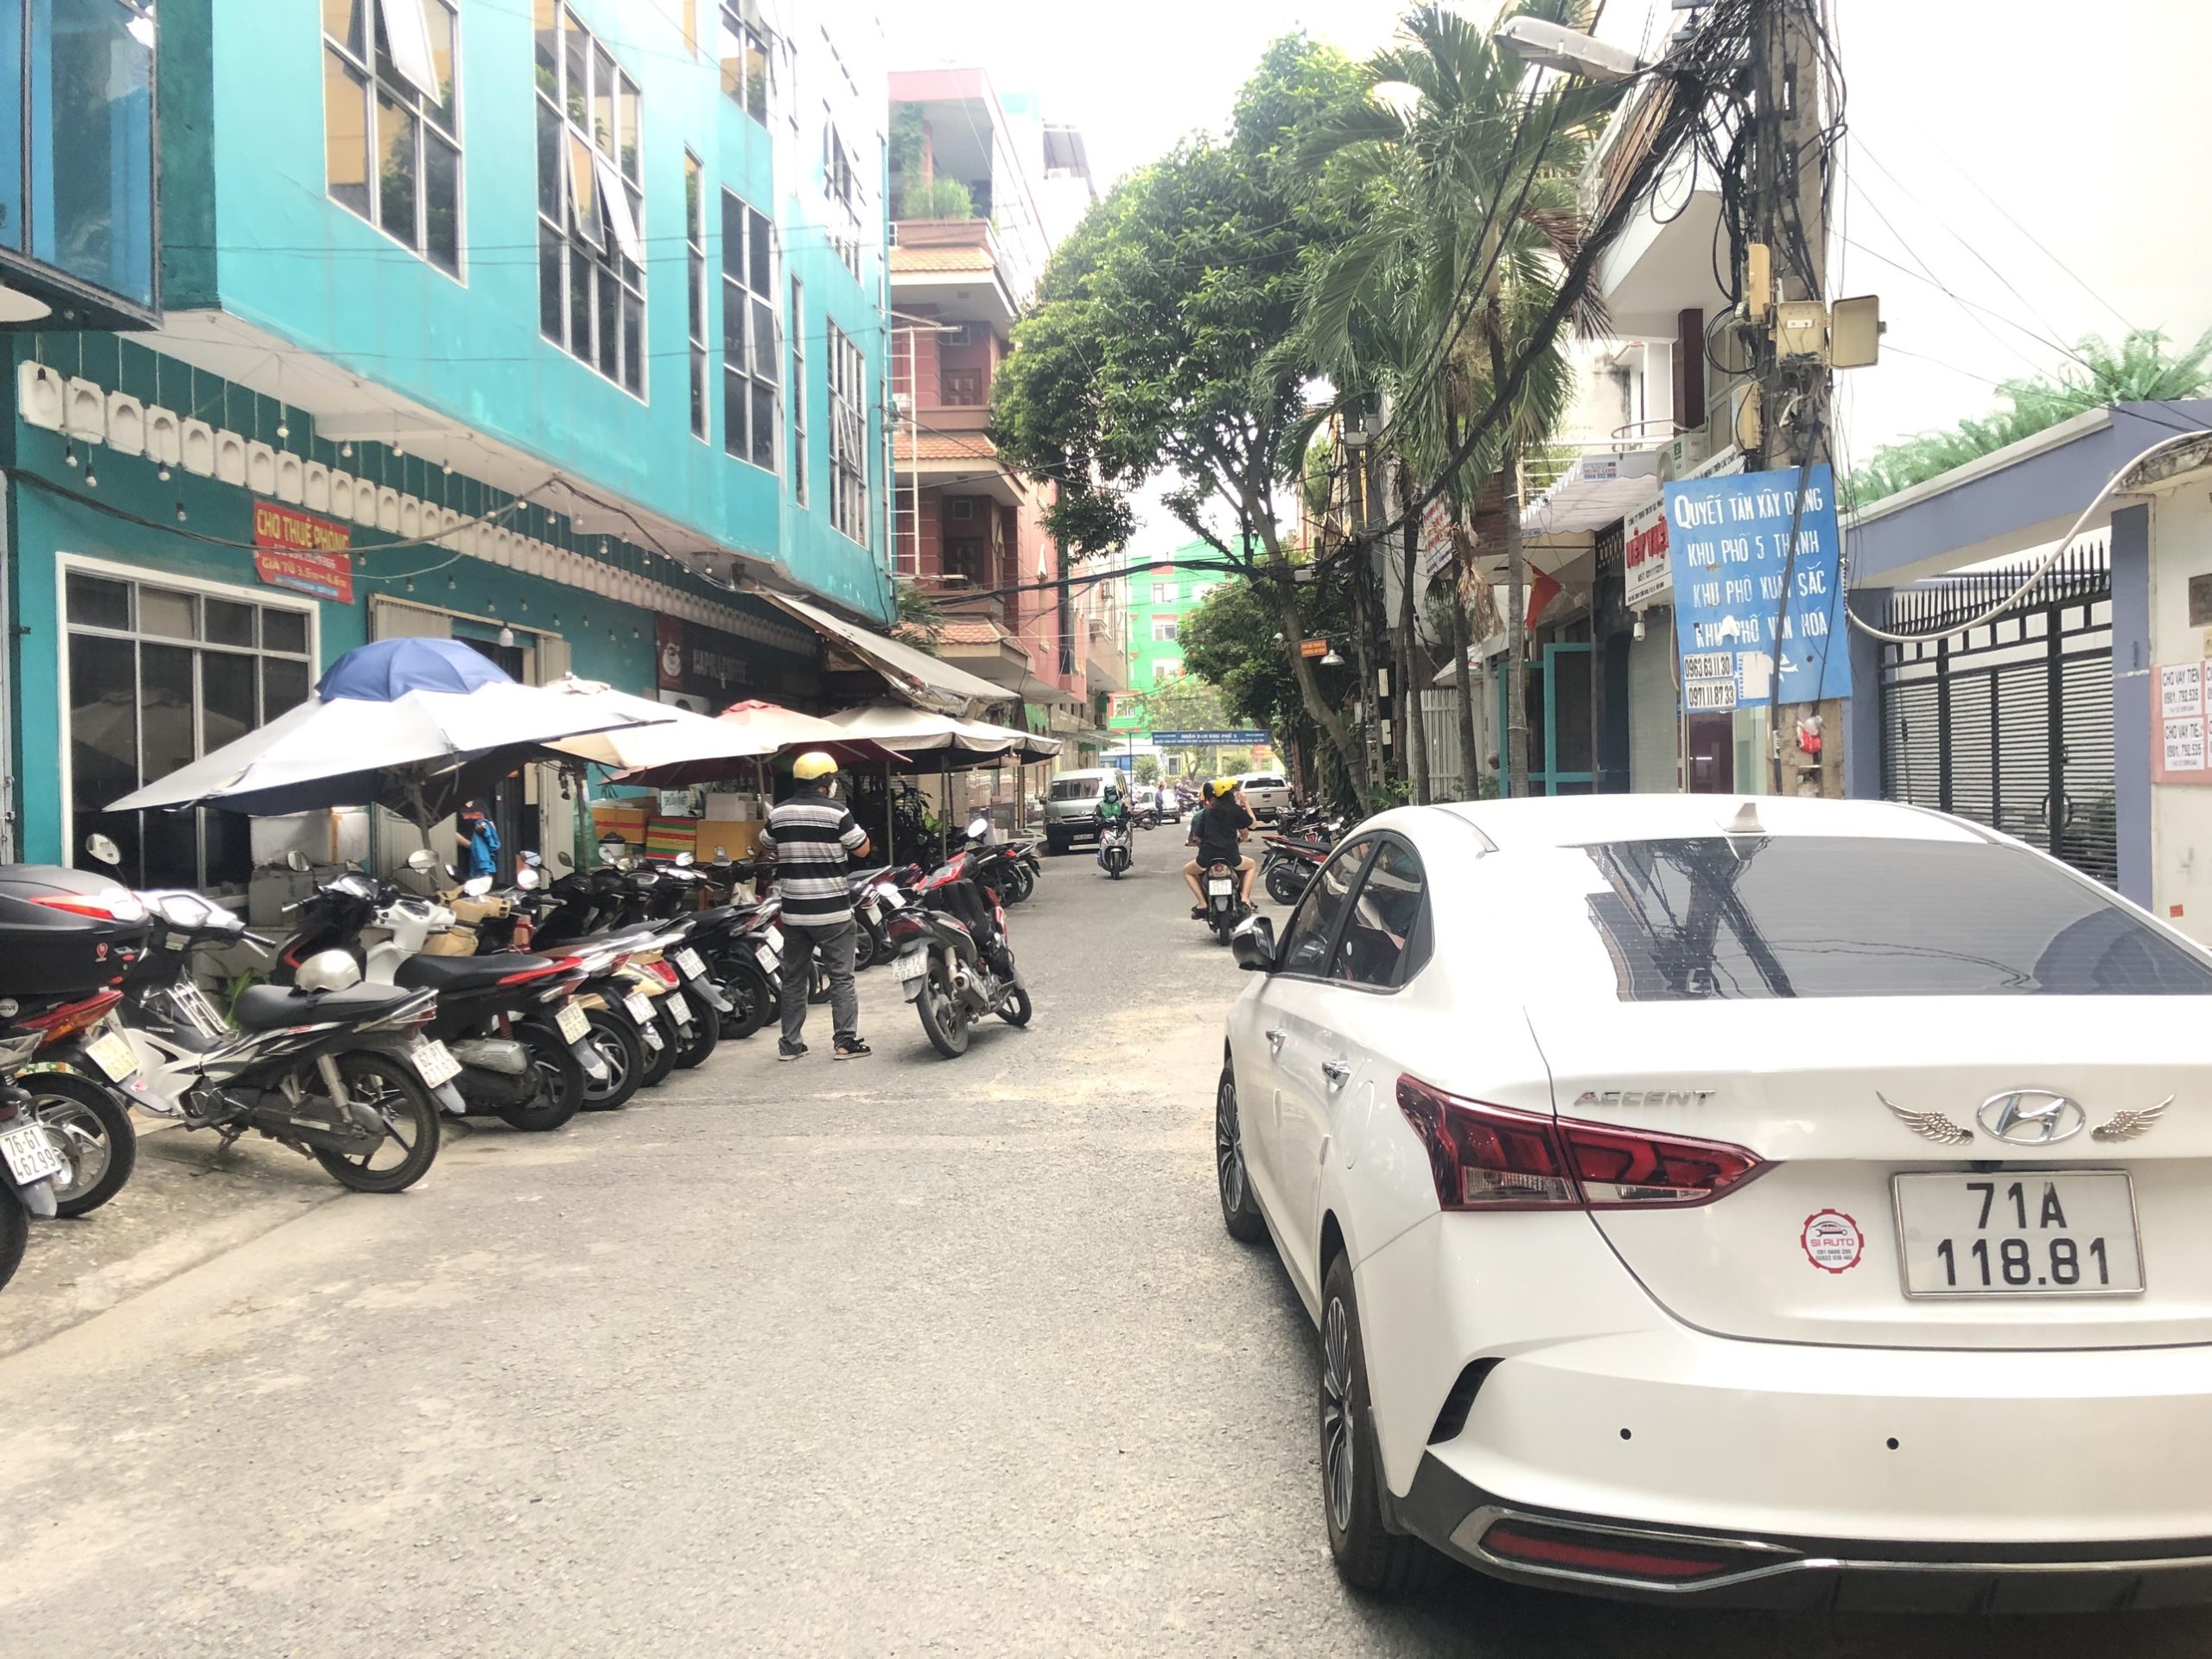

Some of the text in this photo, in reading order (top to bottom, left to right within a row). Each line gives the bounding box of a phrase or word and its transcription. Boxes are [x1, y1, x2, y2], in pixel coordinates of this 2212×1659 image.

[1674, 493, 1724, 530] QUYẾT
[1757, 488, 1782, 519] XÂY
[257, 508, 281, 540] CHO
[283, 516, 313, 547] THUÊ
[1687, 539, 1715, 567] KHU
[1721, 531, 1751, 563] PHỐ
[1755, 536, 1764, 560] 5
[1692, 582, 1720, 607] KHU
[1797, 562, 1827, 597] SẮC
[2162, 672, 2174, 687] CHO
[2175, 670, 2185, 685] VAY
[2165, 725, 2177, 740] CHO
[2177, 723, 2189, 739] VAY
[1573, 1090, 1717, 1107] ACCENT
[4, 1129, 41, 1157] 76-G1
[13, 1148, 56, 1179] 462.99
[1966, 1182, 2068, 1229] 71A
[1810, 1237, 1855, 1247] SI AUTO
[1937, 1237, 2109, 1286] 118.81
